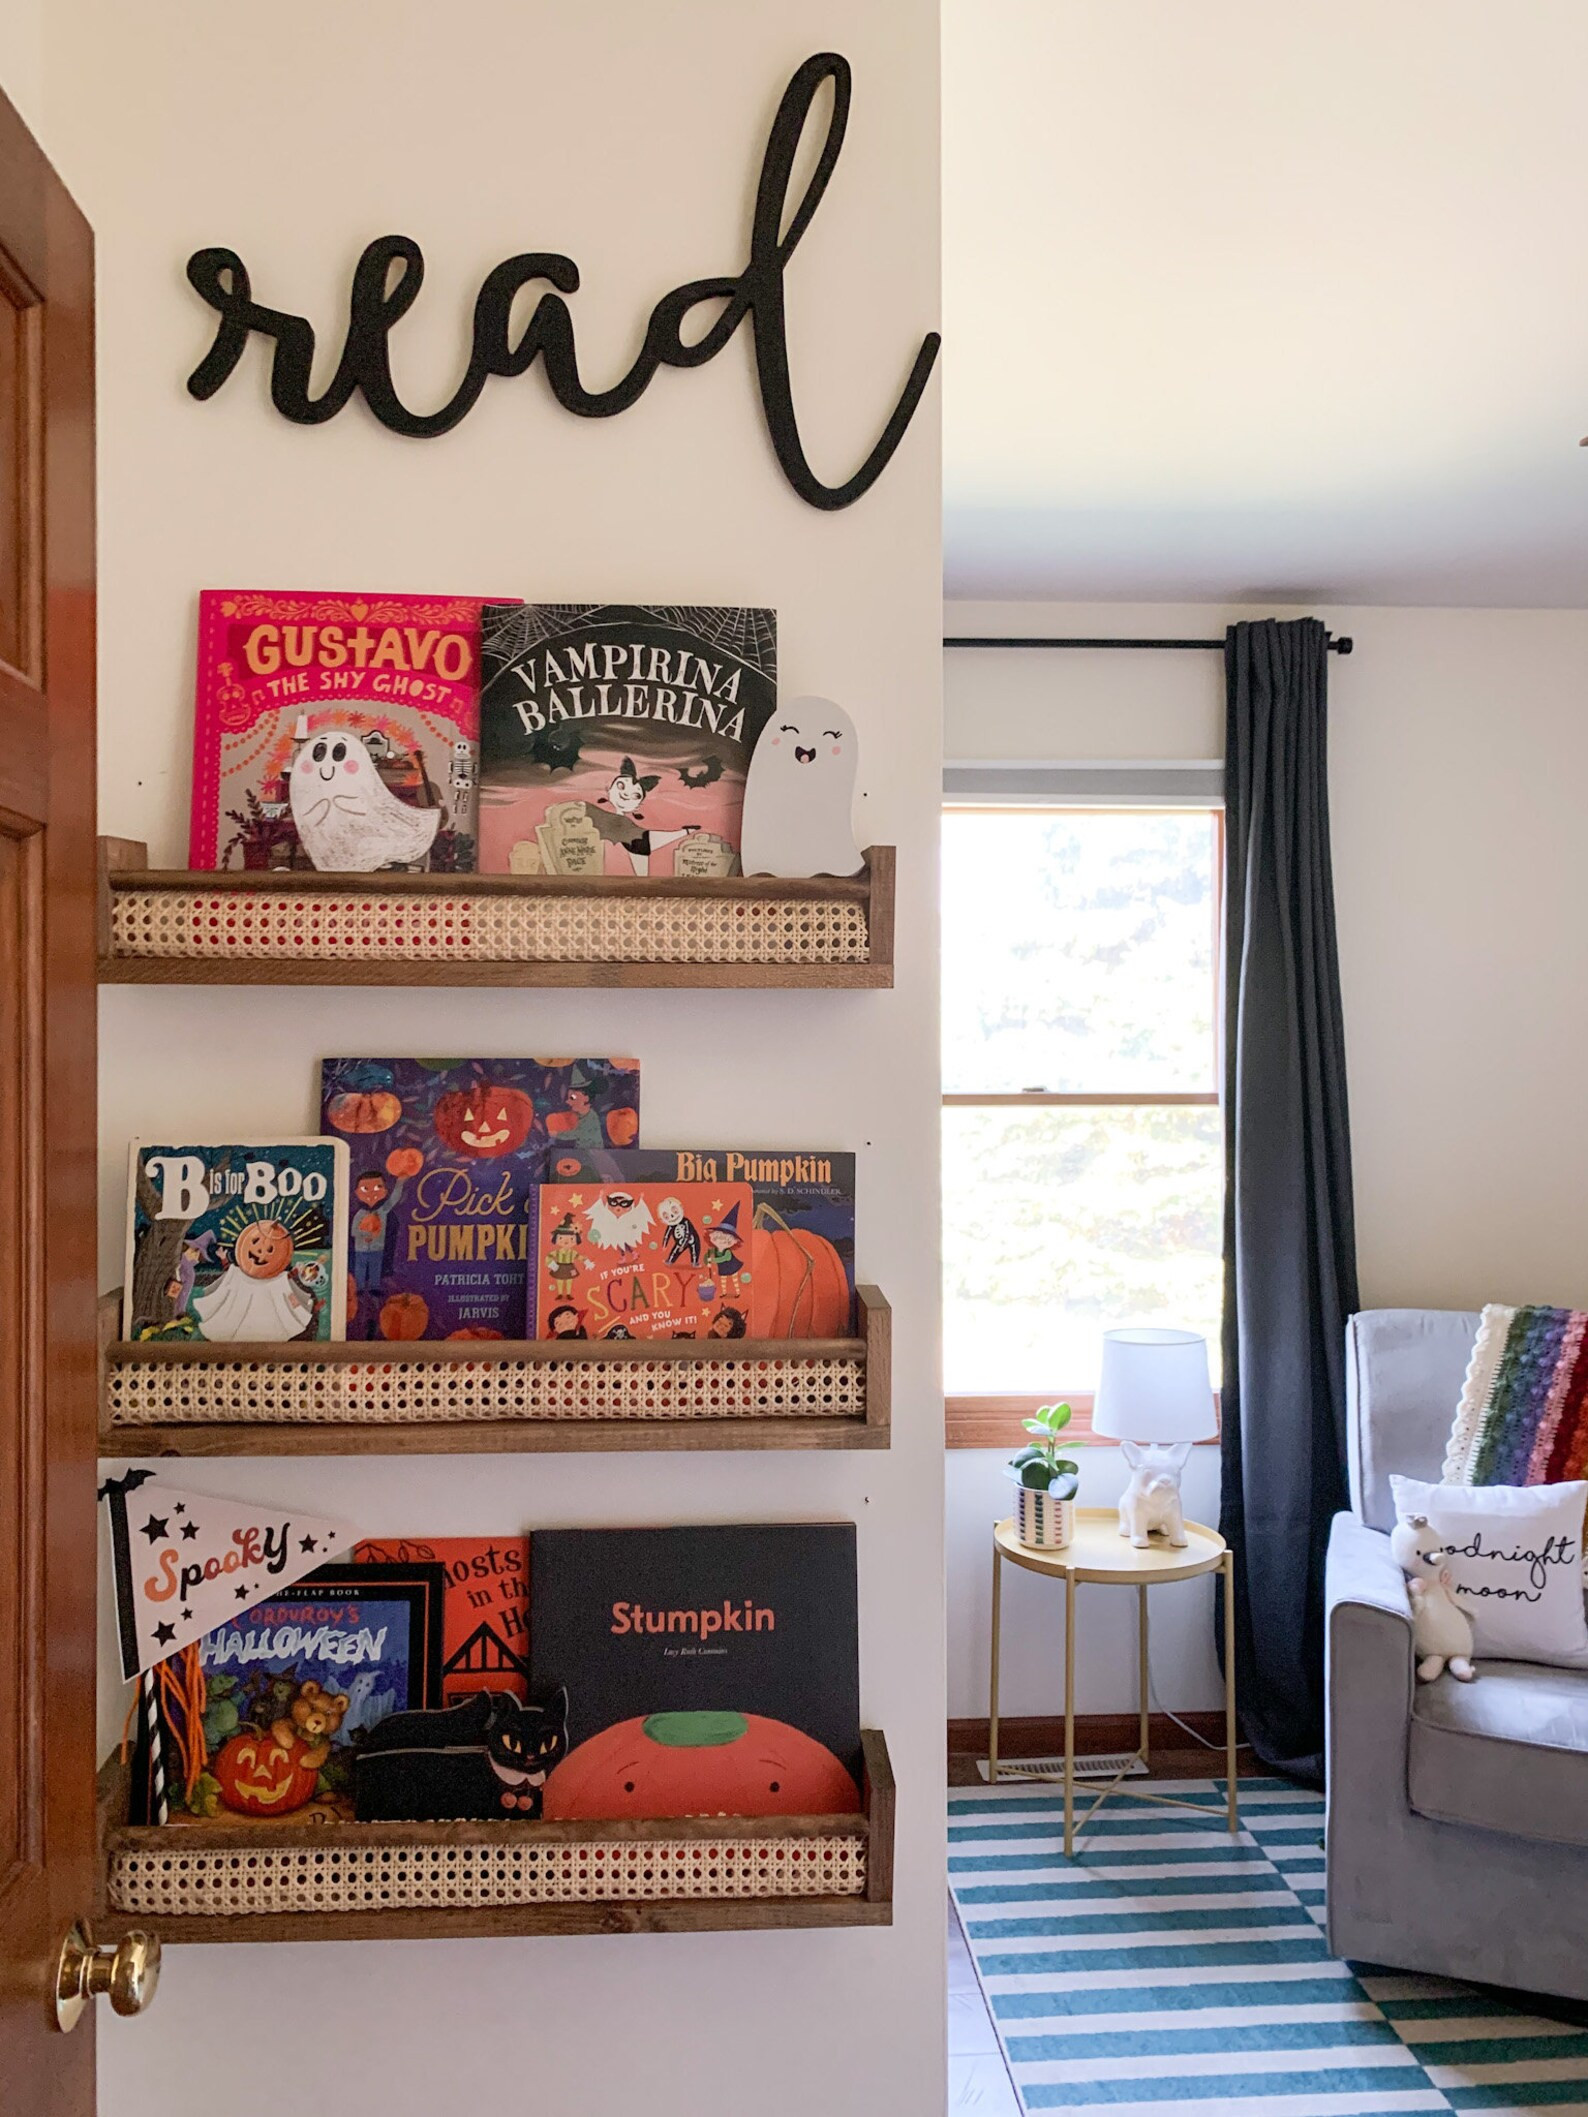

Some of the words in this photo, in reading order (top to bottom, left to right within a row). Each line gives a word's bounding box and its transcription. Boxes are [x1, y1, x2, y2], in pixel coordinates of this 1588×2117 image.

[187, 52, 941, 511] read
[266, 672, 310, 698] THE
[319, 671, 366, 690] SHY
[372, 674, 451, 702] GHOST
[510, 642, 742, 704] VAMPIRINA
[512, 684, 746, 743] BALLERINA
[676, 1152, 717, 1182] Big
[725, 1152, 832, 1187] Pumpkin
[145, 1156, 209, 1220] B
[210, 1169, 221, 1195] is
[225, 1168, 245, 1195] for
[411, 1167, 515, 1222] Pick
[797, 1187, 842, 1195] SCHINDLER
[434, 1274, 490, 1286] PATRICIA
[494, 1273, 524, 1286] TOHT
[600, 1270, 609, 1281] IF
[611, 1264, 645, 1276] YOU'RE
[586, 1271, 697, 1321] SCARY
[458, 1307, 500, 1320] JARVIS
[629, 1313, 650, 1325] AND
[651, 1310, 671, 1319] YOU
[651, 1316, 682, 1331] KNOW
[684, 1315, 698, 1325] IT!
[144, 1522, 290, 1602] Spooky
[330, 1588, 361, 1597] BOOK
[466, 1589, 494, 1609] in
[1456, 1584, 1542, 1602] moon
[611, 1600, 775, 1640] Stumpkin
[198, 1626, 388, 1667] HALLOWEEN
